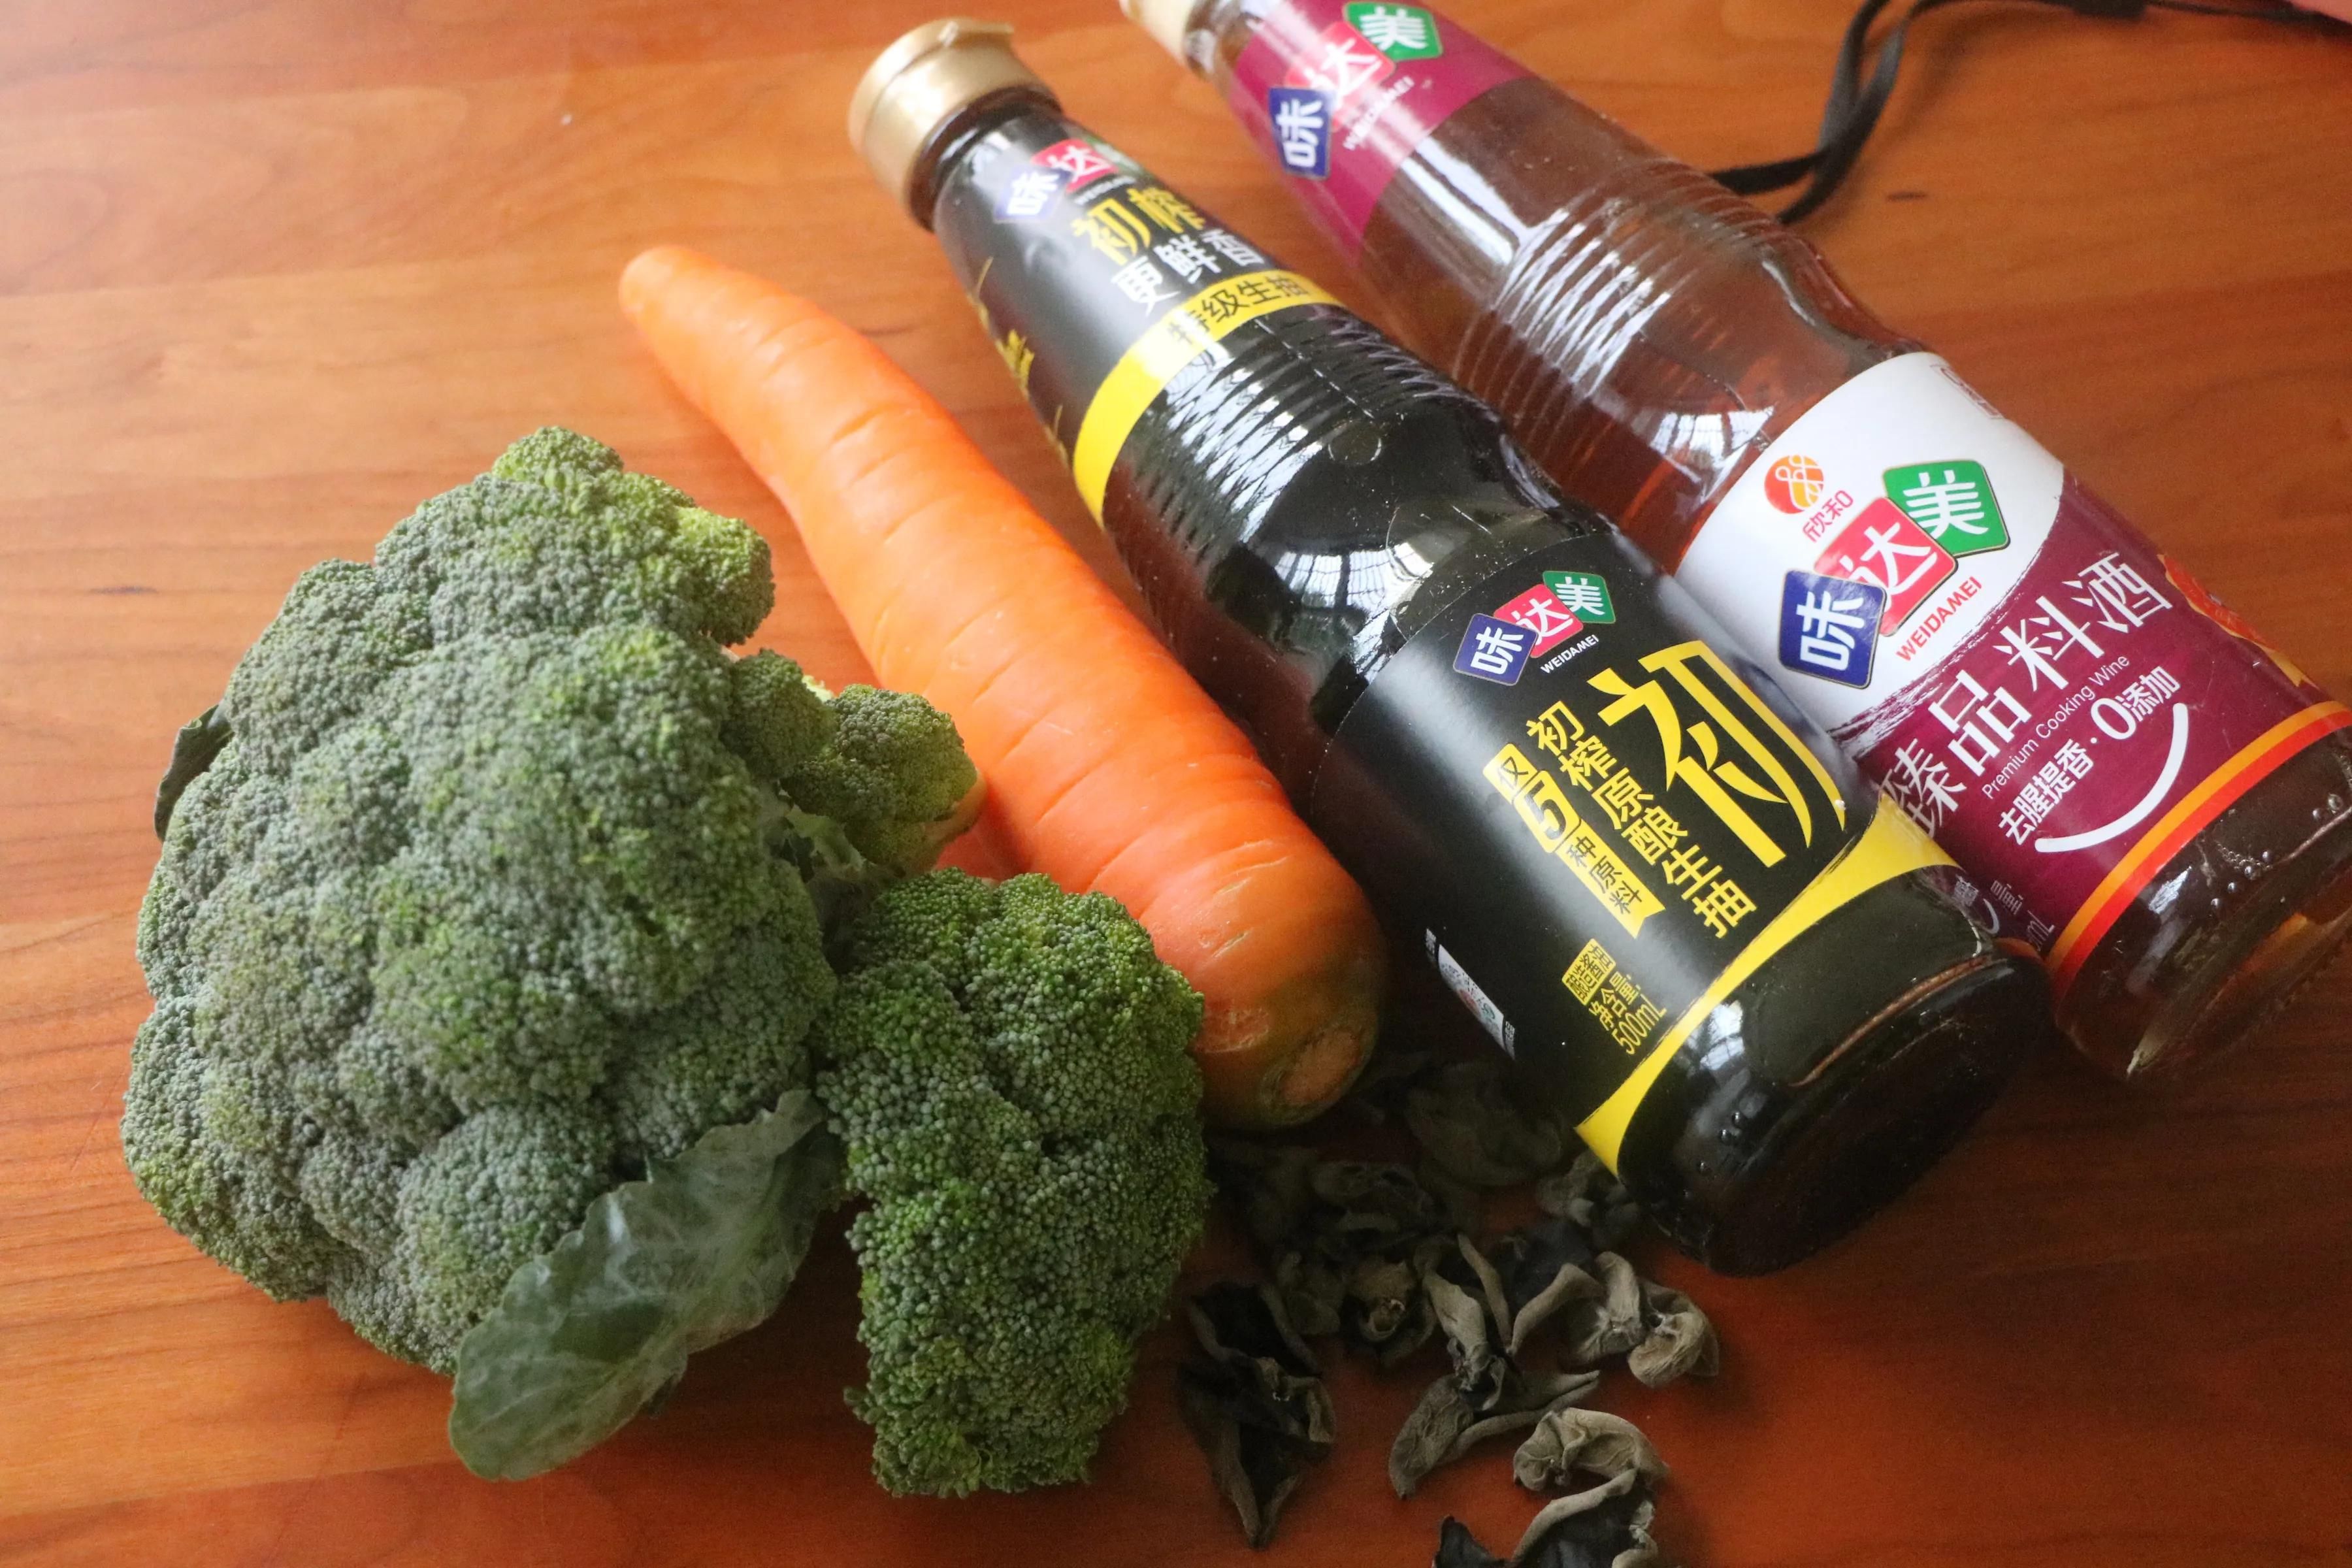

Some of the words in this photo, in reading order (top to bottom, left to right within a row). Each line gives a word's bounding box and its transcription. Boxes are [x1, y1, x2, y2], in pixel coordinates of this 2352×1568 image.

[1275, 6, 1428, 168] 味达美
[1802, 489, 1854, 543] 欣和
[1796, 469, 1989, 672] 味达美
[1896, 576, 1983, 662] WEIDAMEI
[1470, 576, 1605, 676] 味达美
[1540, 634, 1600, 674] WEIDAMEI
[1586, 640, 1846, 868] 初
[1981, 738, 2040, 800] Premium
[2035, 685, 2096, 739] Cooking
[2088, 655, 2131, 687] Wine
[1526, 700, 1757, 939] 初榨原酿生抽
[1566, 943, 1614, 1002] 酿造酱油
[1611, 993, 1667, 1055] 500mL
